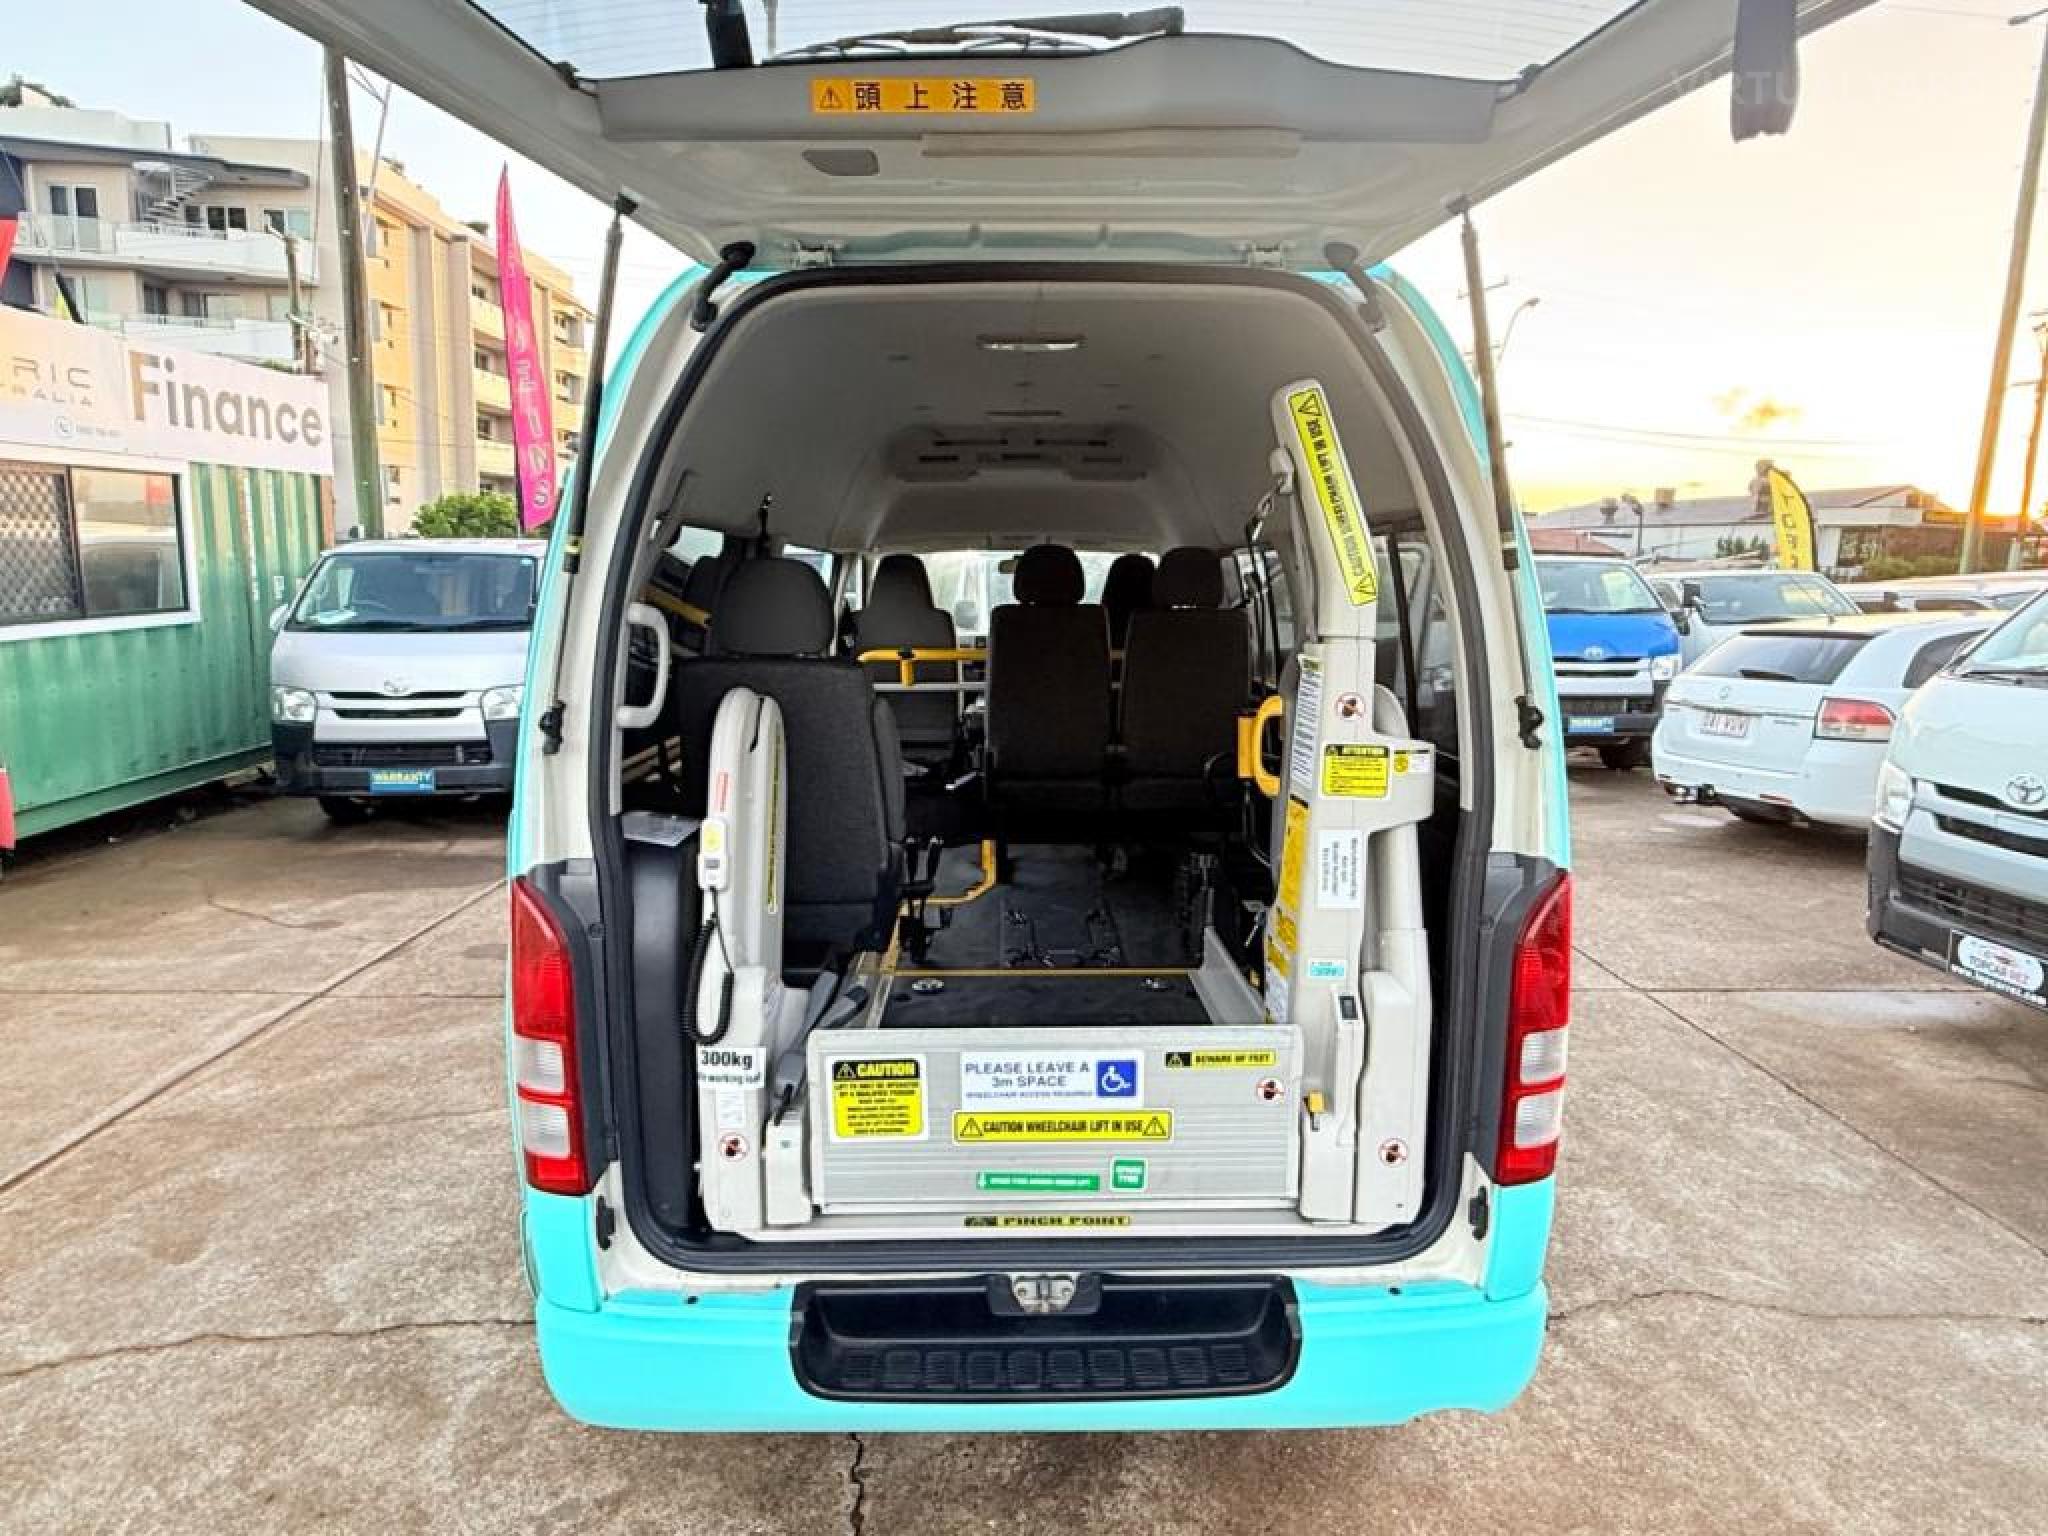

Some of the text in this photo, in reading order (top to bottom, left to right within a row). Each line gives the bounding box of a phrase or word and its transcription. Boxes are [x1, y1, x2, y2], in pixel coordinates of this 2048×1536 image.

[853, 81, 1027, 111] 頭上注意
[0, 381, 93, 408] RALIA
[129, 350, 324, 447] Finance
[701, 1050, 752, 1070] 300kg
[965, 1061, 1090, 1075] PLEASE LEAVE A
[857, 1062, 915, 1078] CAUTION
[991, 1075, 1067, 1088] 3m SPACE
[983, 1119, 1143, 1133] CAUTION WHEELCHAIR LIFT IN USE
[1003, 1217, 1124, 1226] PINCH POINT
